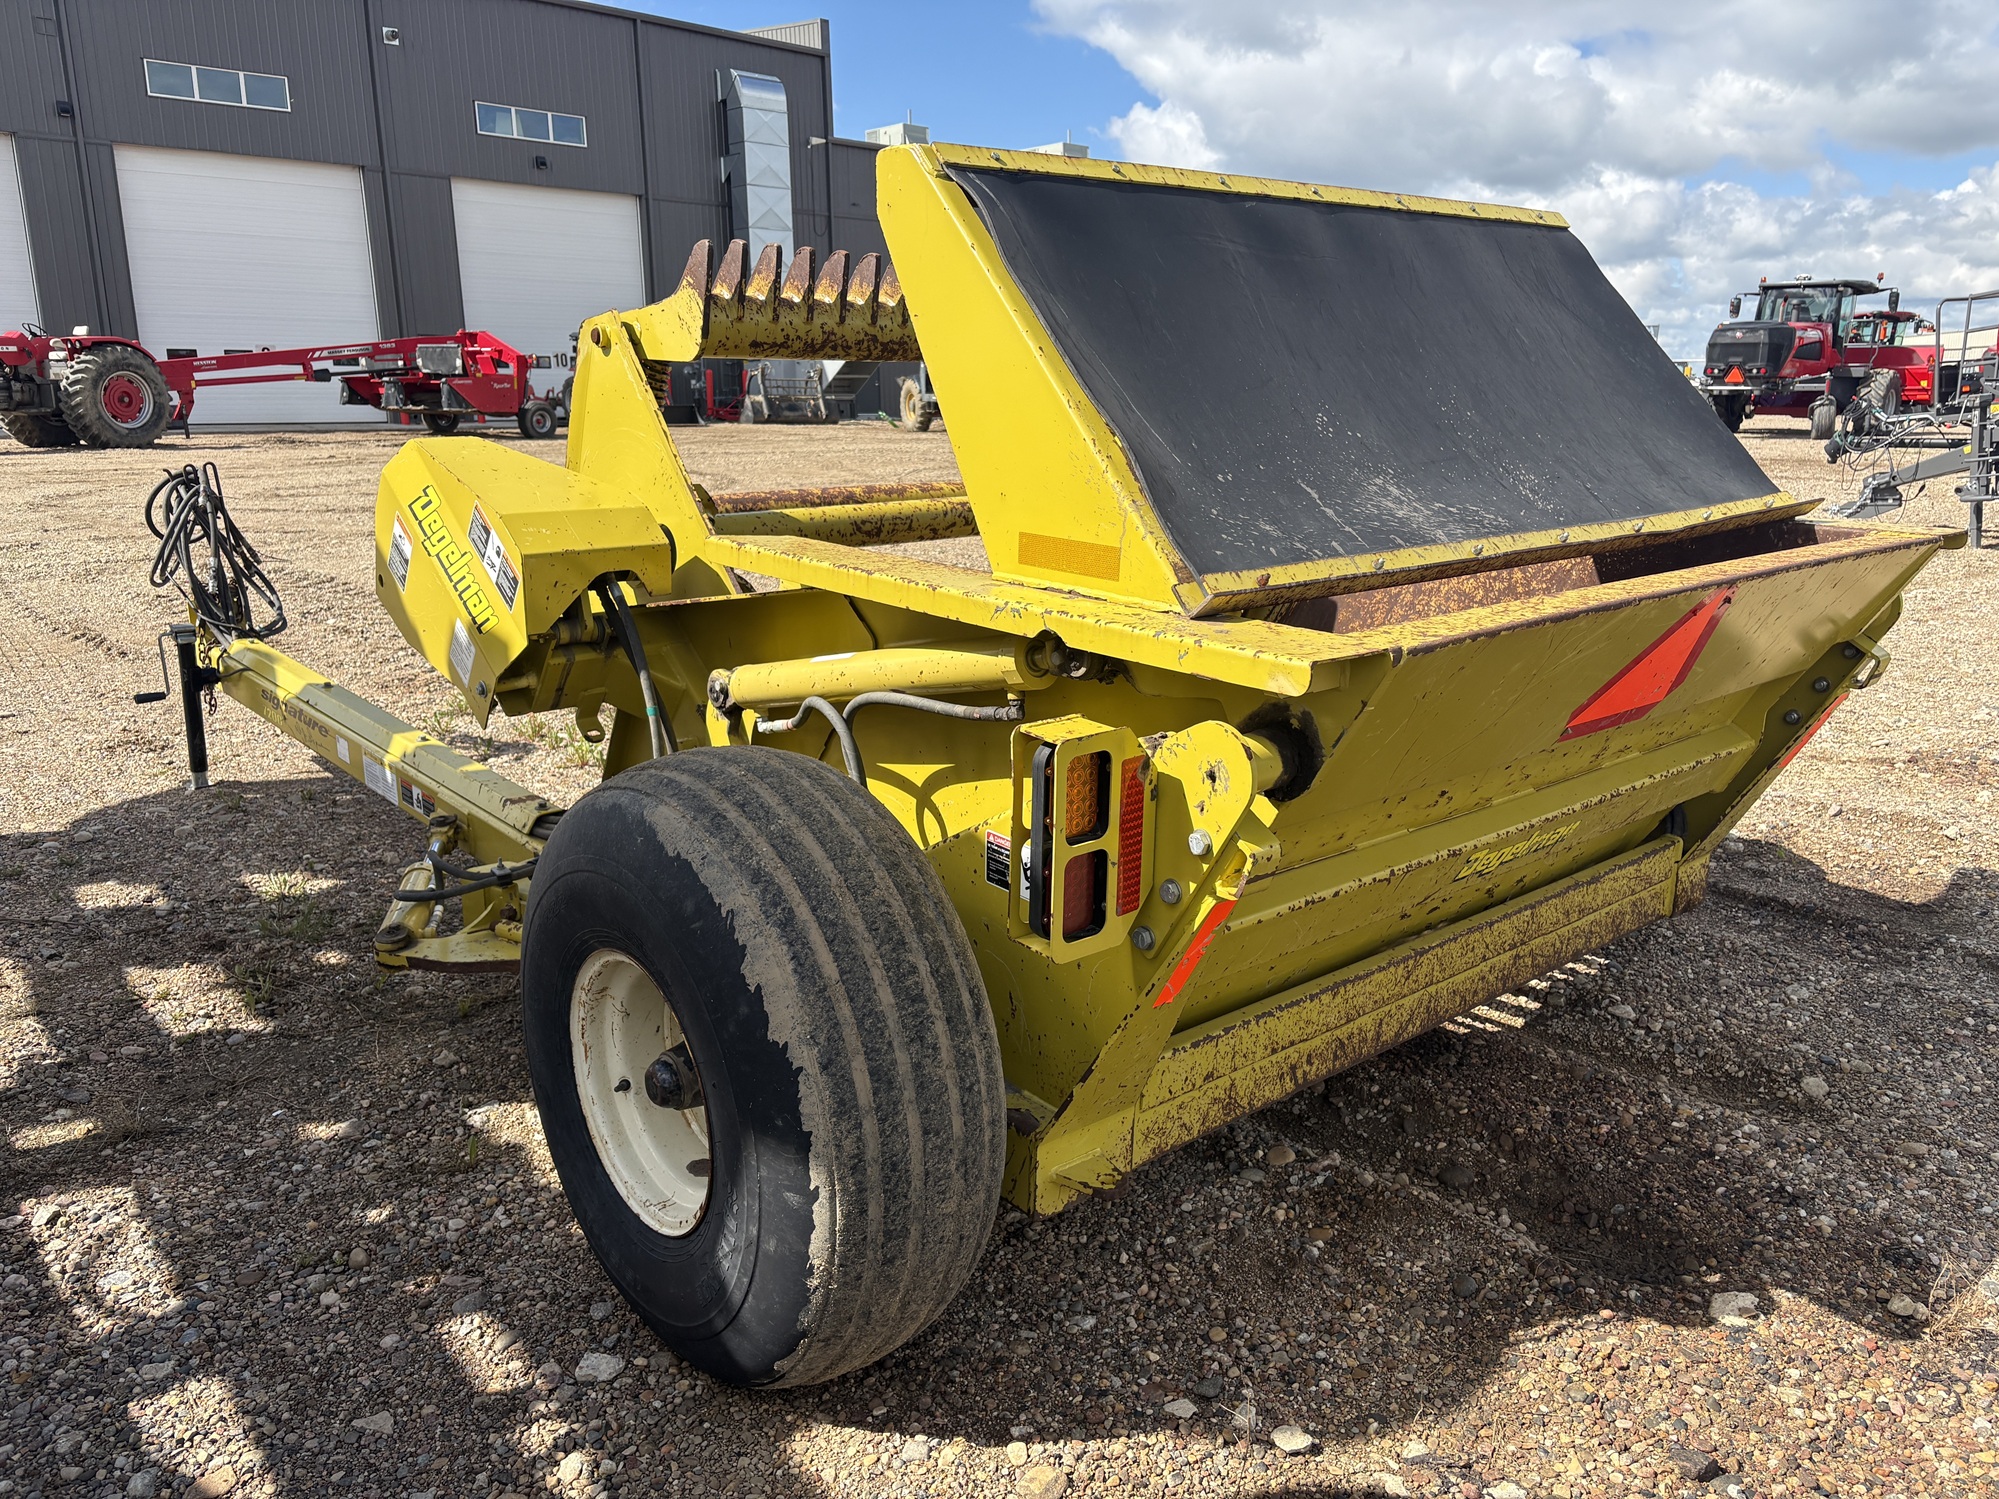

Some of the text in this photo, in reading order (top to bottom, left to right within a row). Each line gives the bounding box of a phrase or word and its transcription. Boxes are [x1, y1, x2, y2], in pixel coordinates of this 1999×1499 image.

[553, 353, 568, 367] 10
[407, 484, 501, 635] Degelman
[261, 688, 329, 738] signature
[994, 835, 1011, 848] DANGE
[1452, 820, 1582, 881] Degelman
